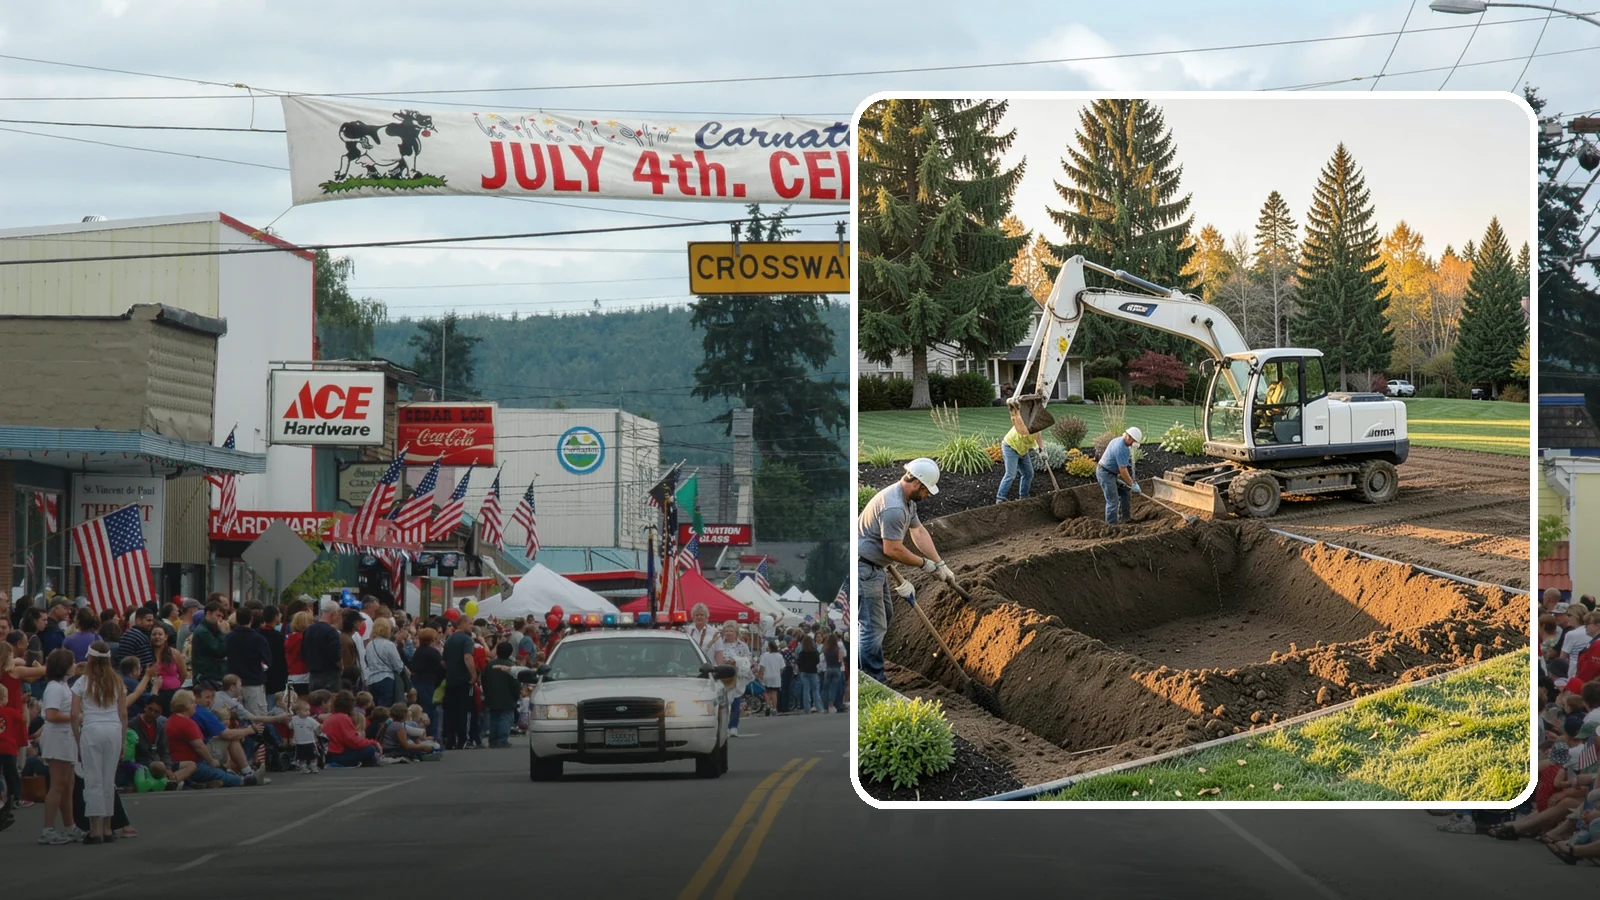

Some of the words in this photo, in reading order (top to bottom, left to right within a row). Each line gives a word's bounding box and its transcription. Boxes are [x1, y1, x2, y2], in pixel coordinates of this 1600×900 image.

[481, 141, 604, 192] JULY
[633, 150, 746, 198] 4th.
[696, 254, 850, 280] CROSSWA
[283, 380, 373, 420] ACE
[405, 409, 452, 421] CEDAR
[461, 409, 485, 421] LOG
[283, 421, 371, 436] Hardware
[416, 428, 477, 447] Coca-Cola
[353, 467, 386, 480] Simpl
[83, 485, 93, 494] St.
[95, 485, 124, 495] Vincent
[126, 486, 135, 495] de
[137, 486, 155, 495] Paul
[688, 526, 741, 535] CRNATION
[699, 535, 730, 543] GLASS
